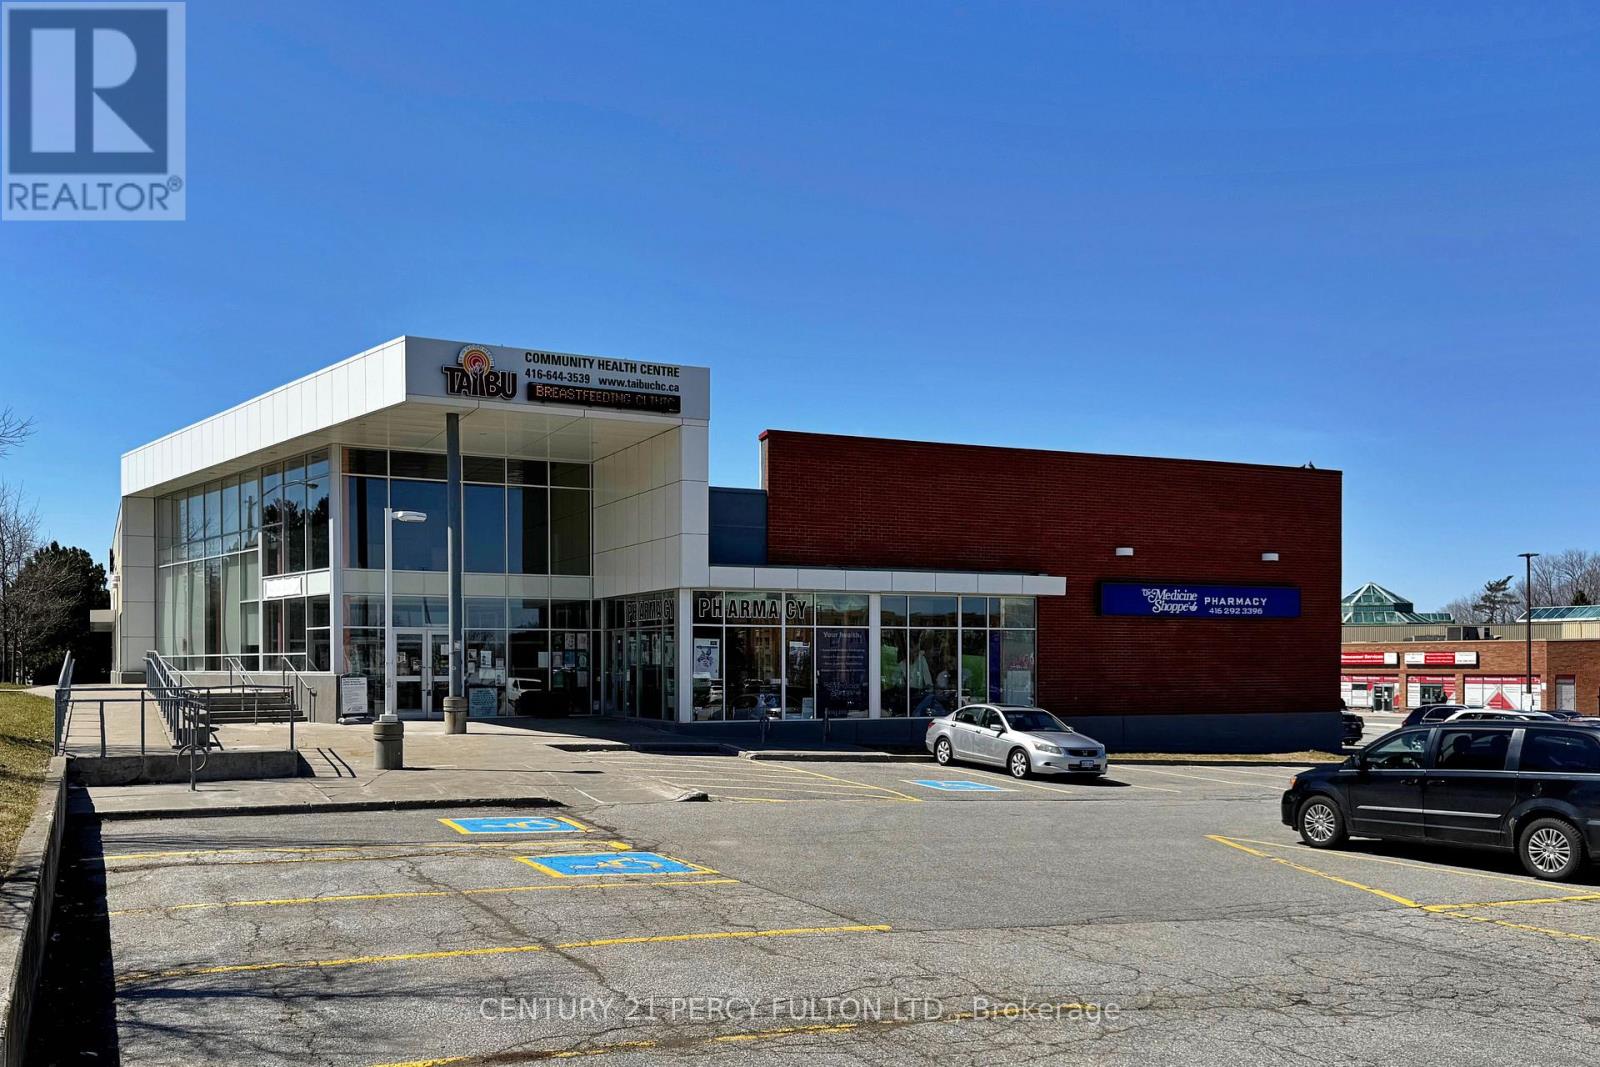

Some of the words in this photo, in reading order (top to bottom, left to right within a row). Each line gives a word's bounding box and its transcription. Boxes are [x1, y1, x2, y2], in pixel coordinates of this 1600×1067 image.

[525, 352, 594, 369] COMMUNITY
[598, 359, 637, 374] HEALTH
[640, 364, 680, 378] CENTRE
[525, 368, 590, 384] 416-644-3539
[598, 377, 680, 393] www.taibuchc.ca
[536, 385, 631, 404] BREASTFEEDING
[1148, 589, 1197, 603] Medicine
[1204, 597, 1268, 606] PHARMACY
[699, 597, 807, 619] PHARMACY
[1152, 600, 1190, 614] Shoppe
[1223, 607, 1241, 615] 292
[1241, 607, 1263, 615] 3396
